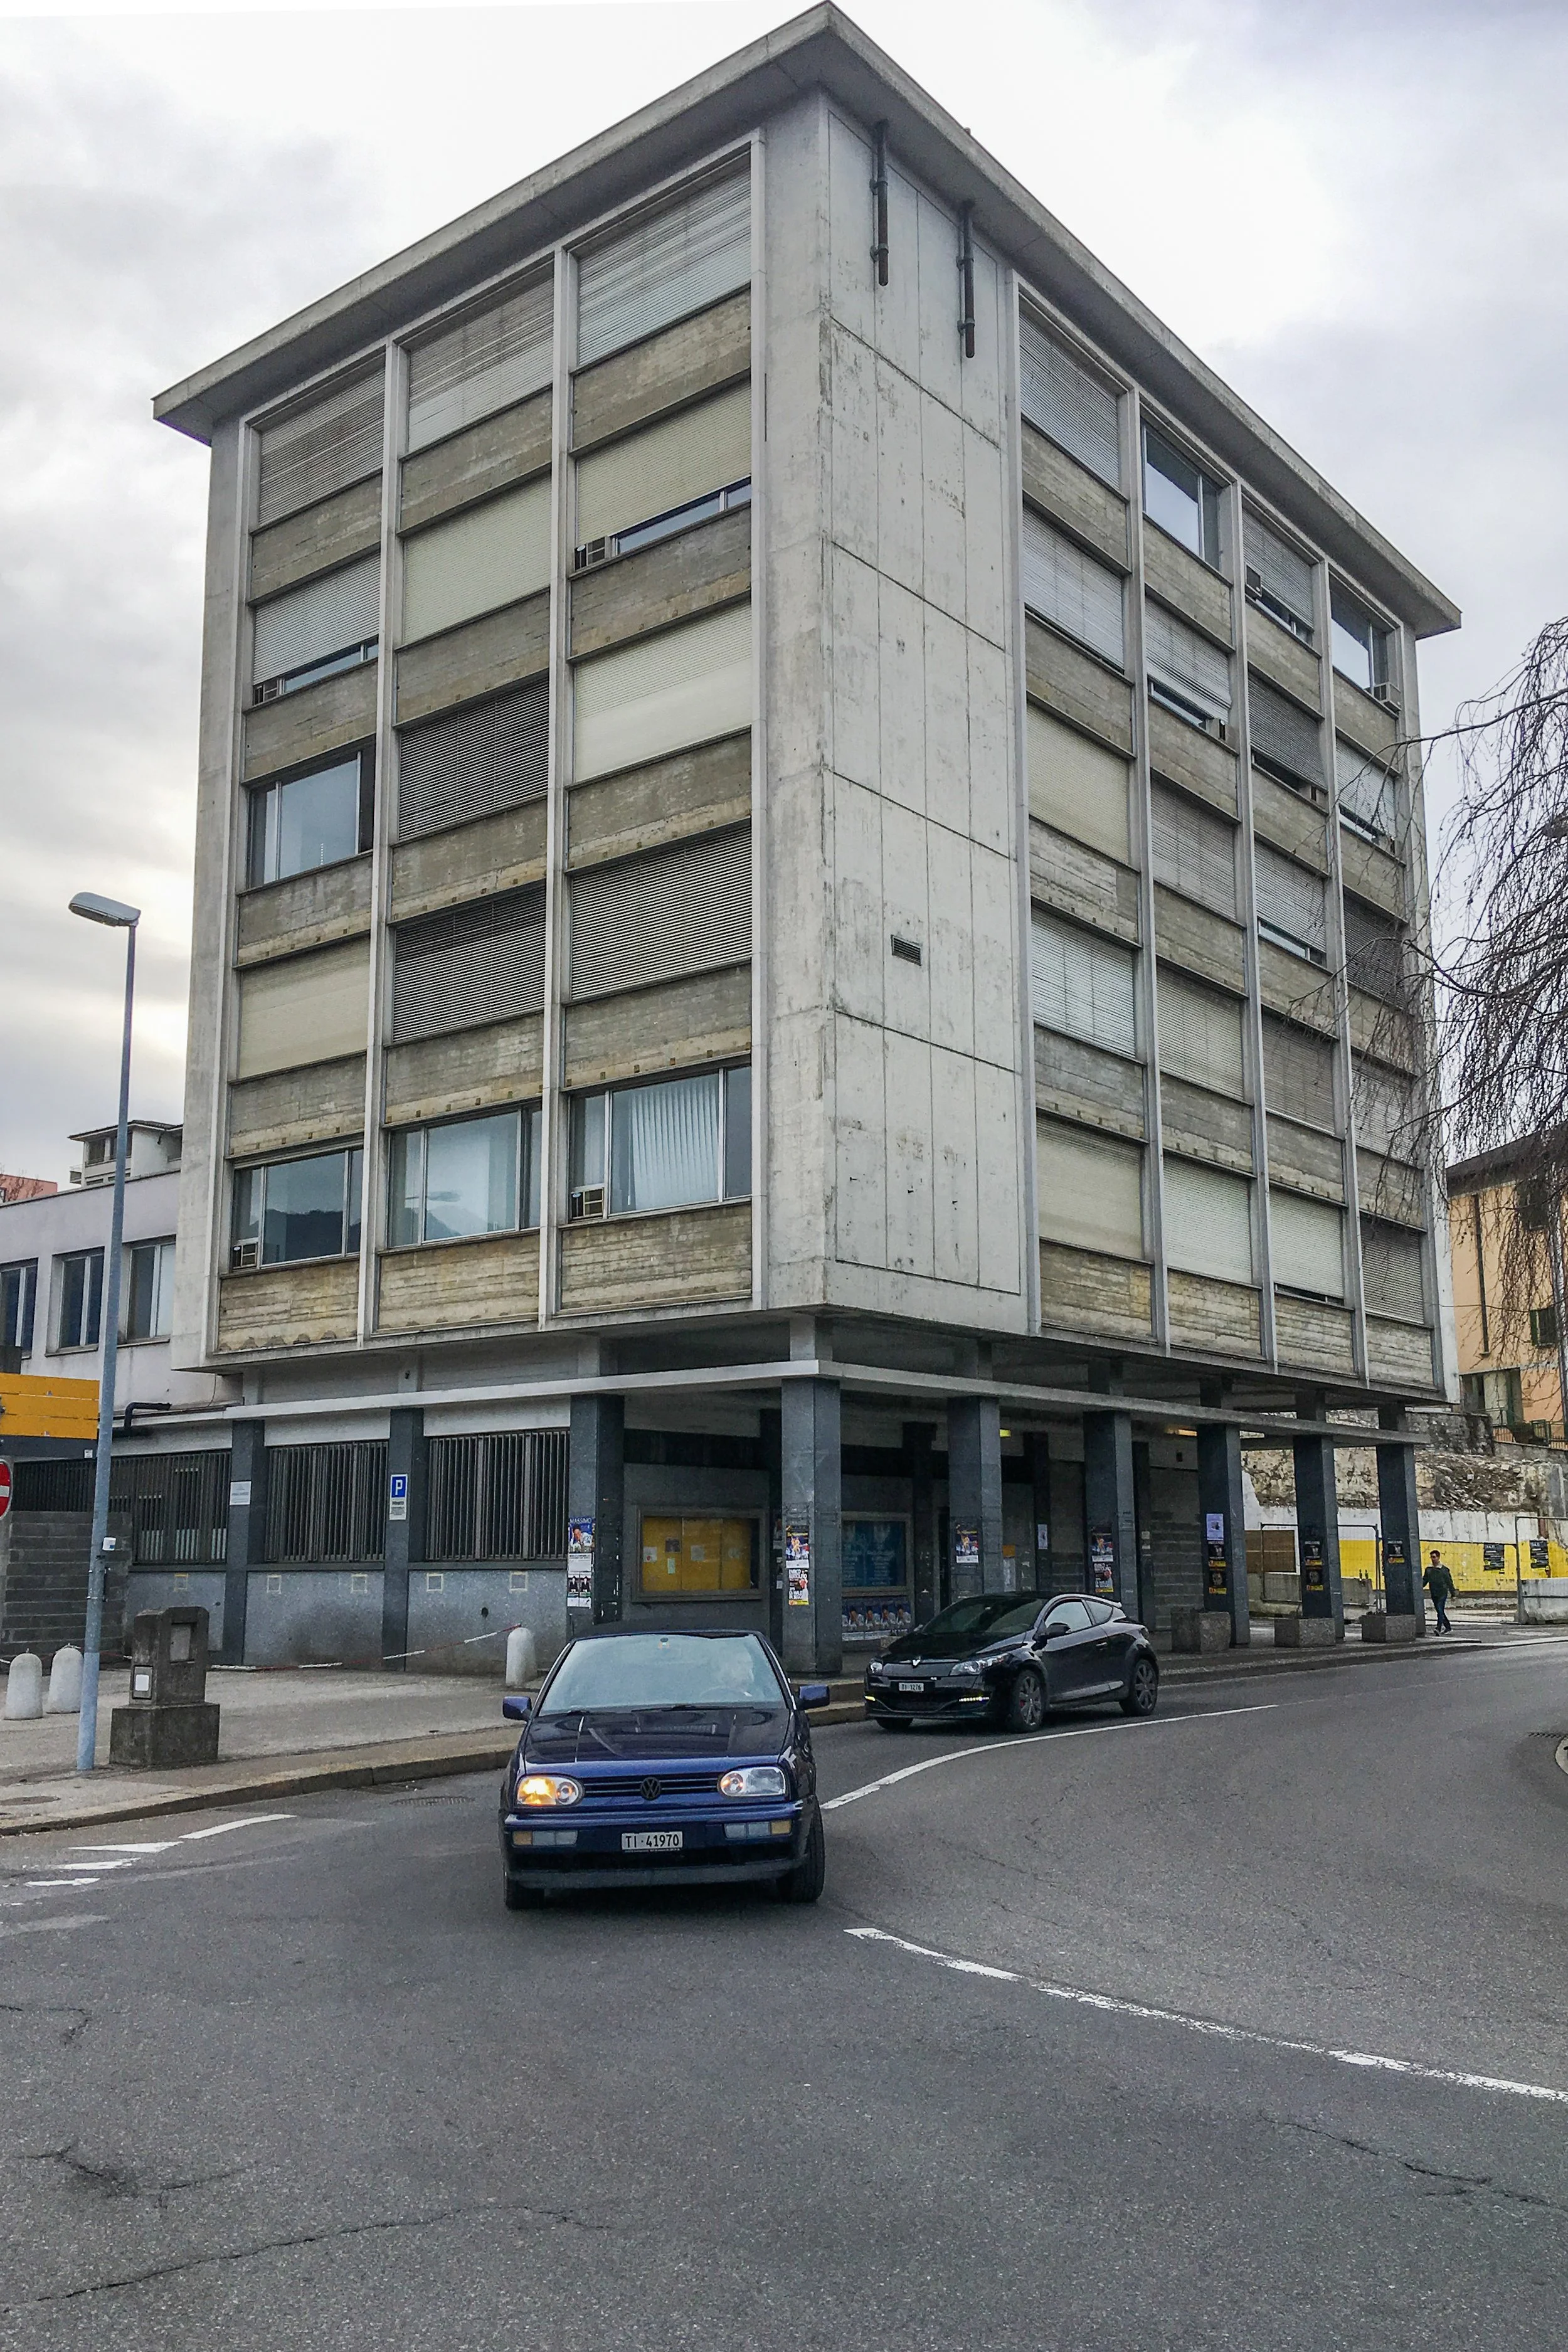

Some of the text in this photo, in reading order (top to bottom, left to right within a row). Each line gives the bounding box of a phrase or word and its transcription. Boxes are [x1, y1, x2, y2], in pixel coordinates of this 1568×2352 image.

[395, 1479, 403, 1496] P
[625, 1833, 679, 1848] TI 41970
